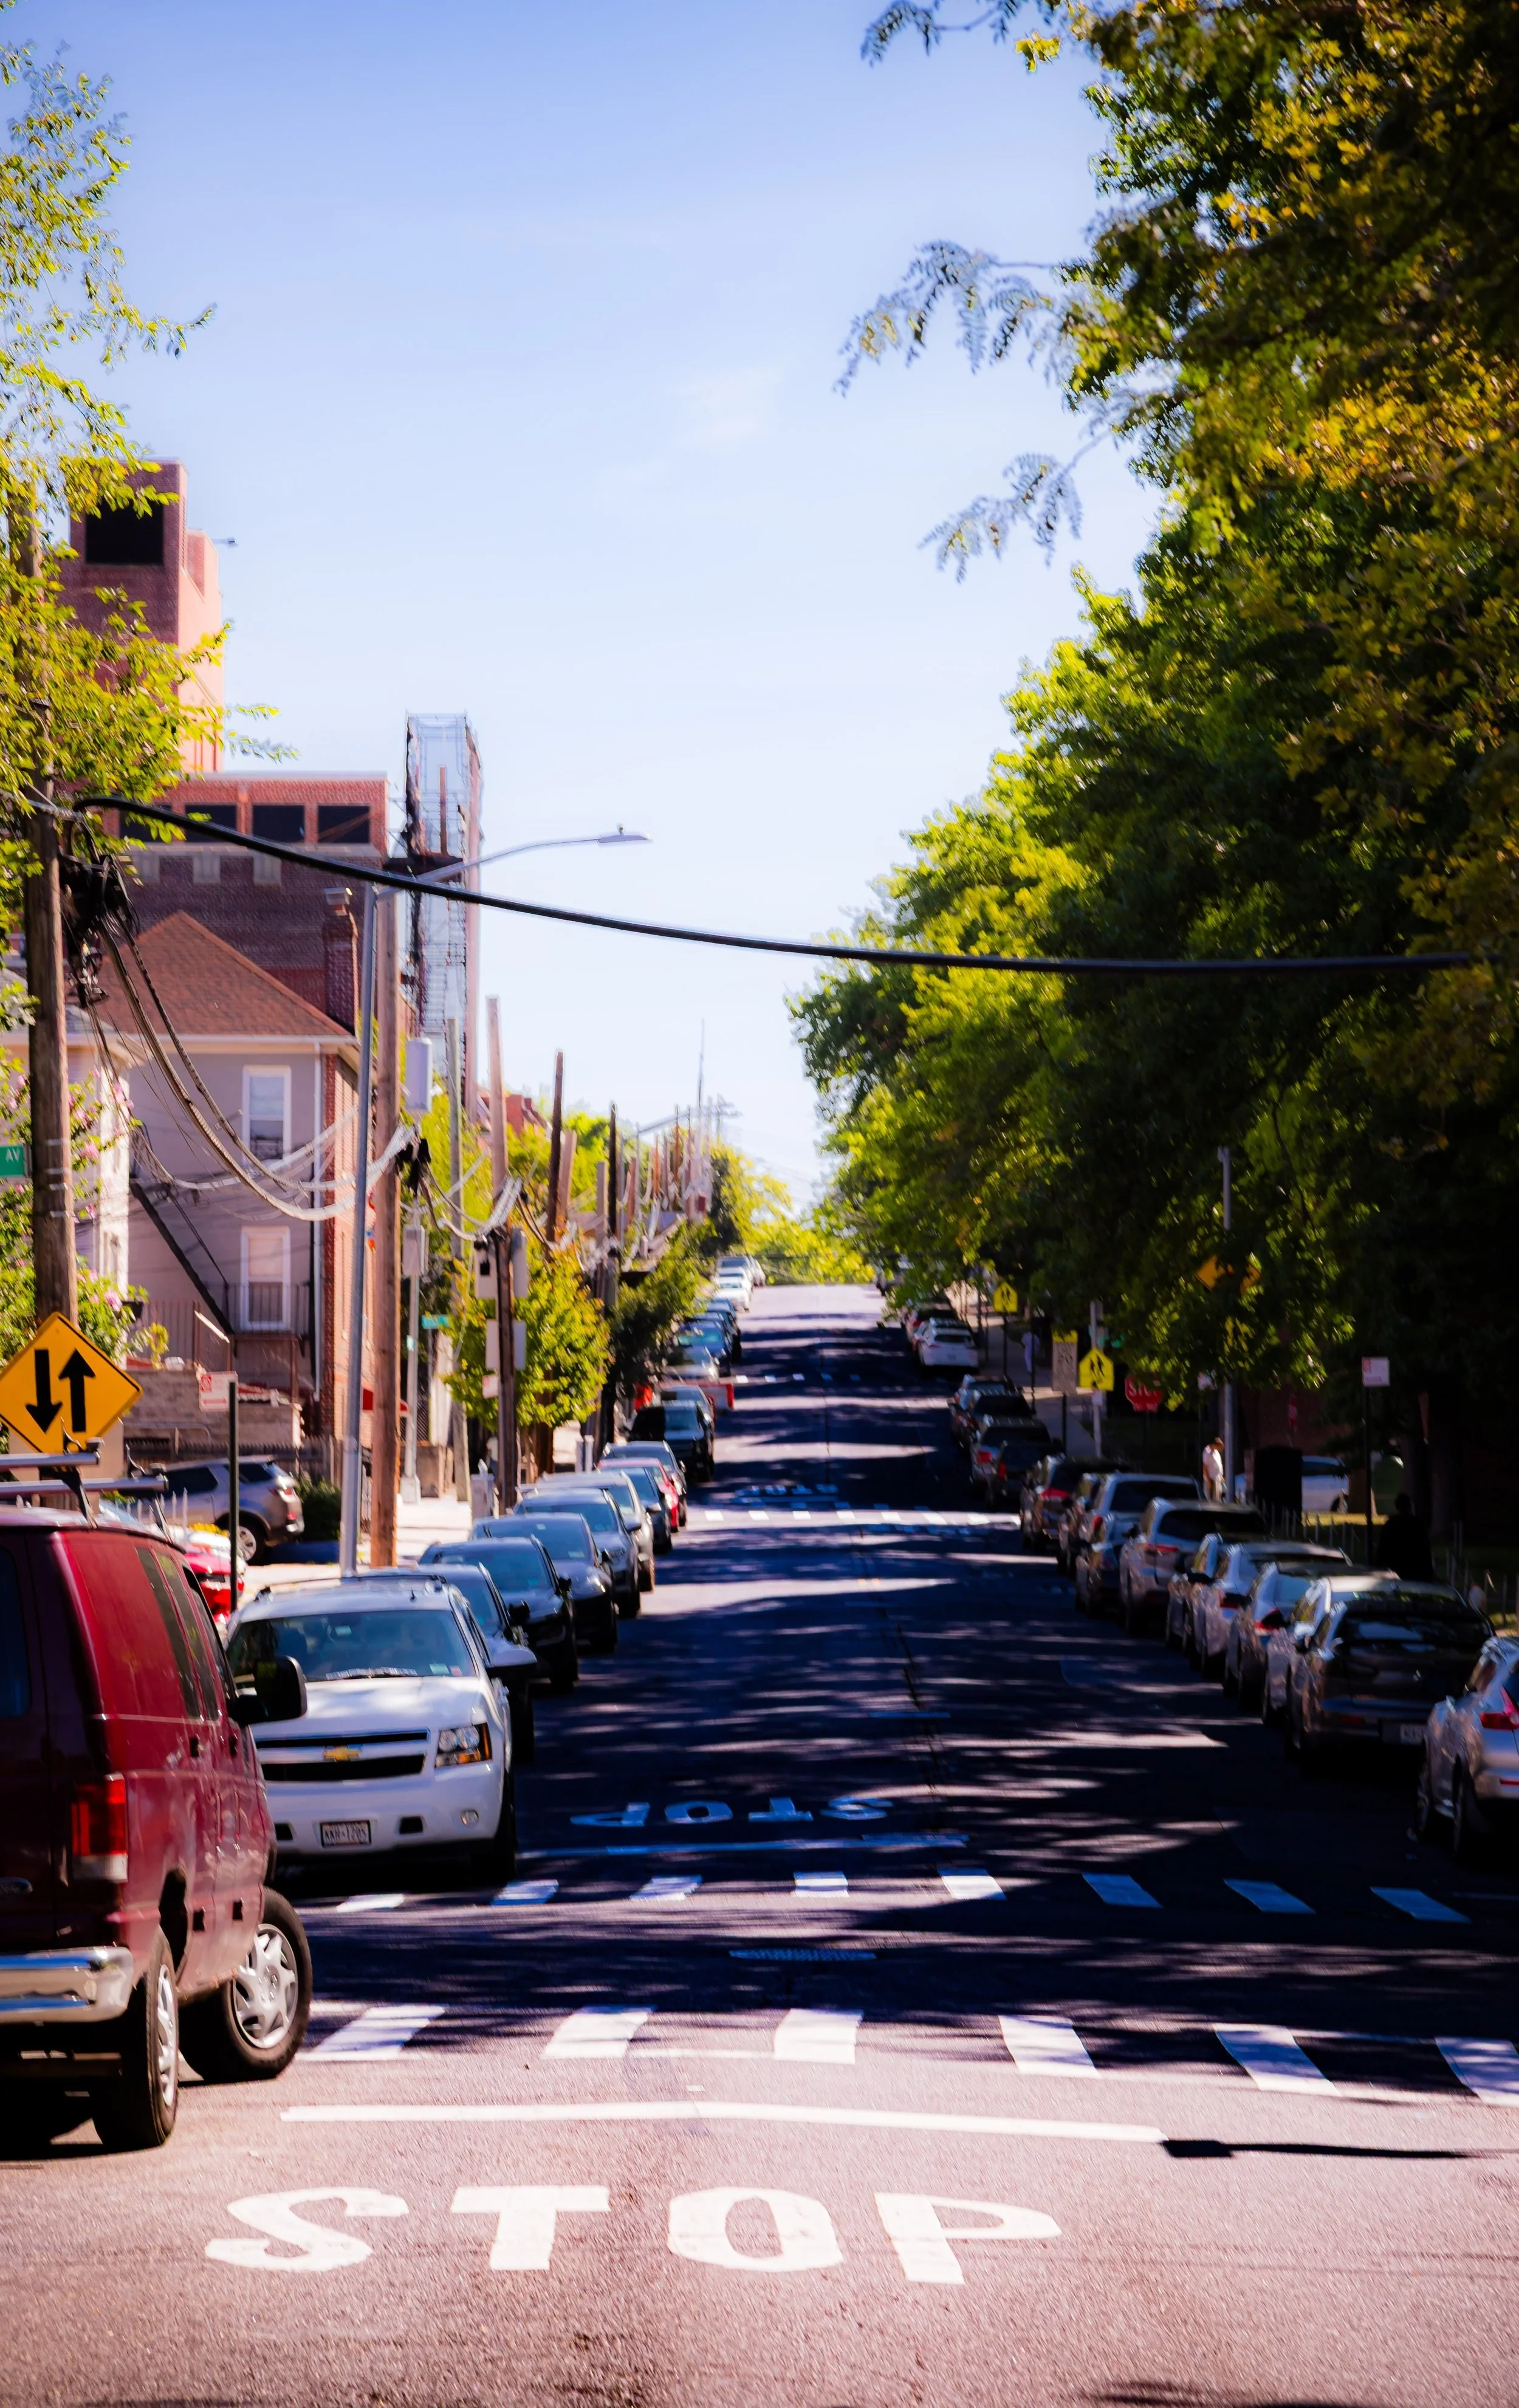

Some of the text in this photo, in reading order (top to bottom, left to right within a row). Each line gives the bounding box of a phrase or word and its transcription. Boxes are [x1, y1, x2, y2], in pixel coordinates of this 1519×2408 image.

[5, 1147, 21, 1163] AV
[570, 1795, 893, 1827] STOP
[204, 2184, 1063, 2285] STOP
